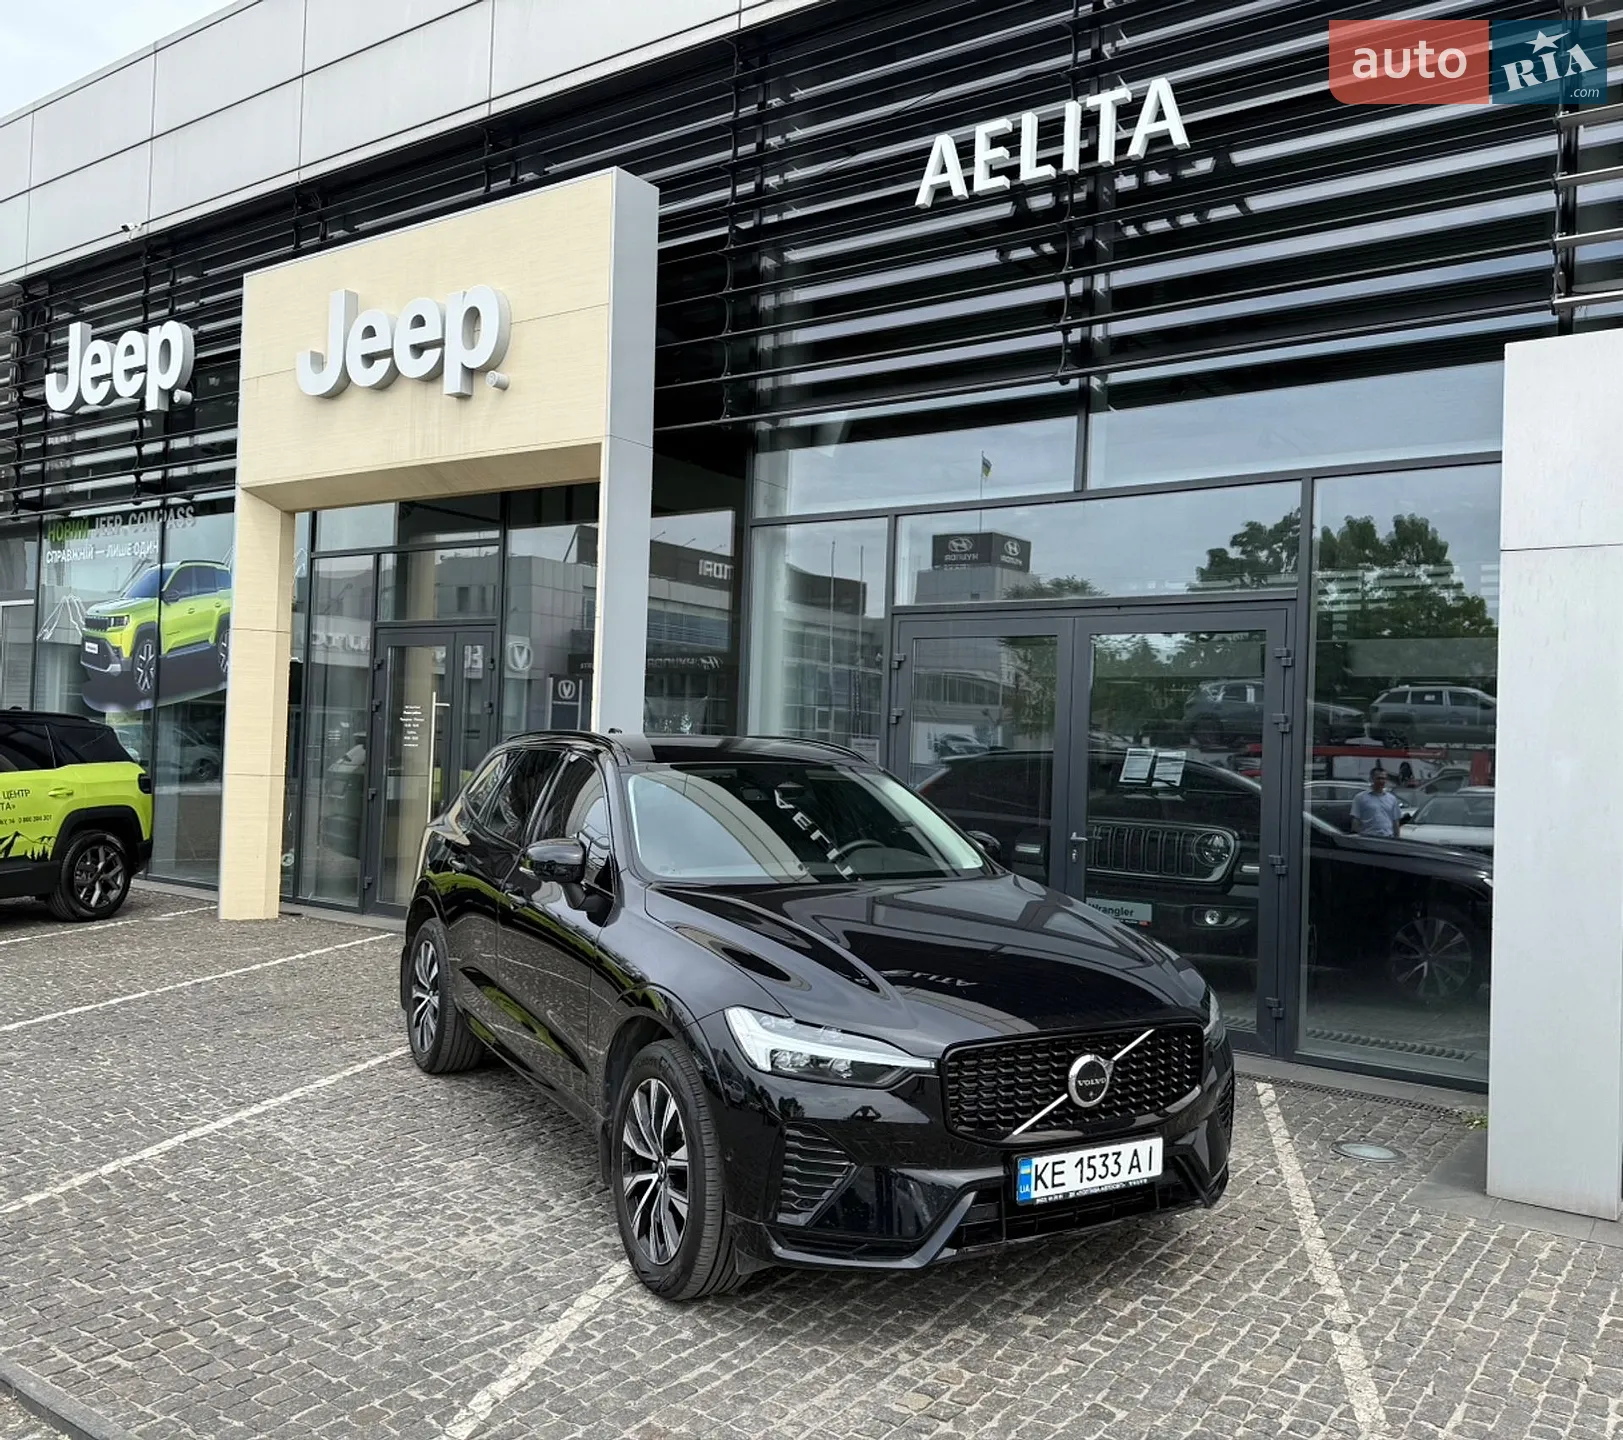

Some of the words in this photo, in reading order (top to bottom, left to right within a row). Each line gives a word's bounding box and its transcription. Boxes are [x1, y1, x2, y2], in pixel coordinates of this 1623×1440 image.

[914, 77, 1191, 209] AELITA
[295, 284, 511, 398] Jeep
[45, 320, 195, 412] Jeep
[47, 515, 91, 541] НОВИЙ
[95, 516, 122, 537] JEEP
[46, 545, 94, 564] СПРАВЖНІЙ
[2, 789, 31, 800] ЦЕНТР
[1077, 1077, 1107, 1087] VOLVO
[1034, 1159, 1066, 1192] KE
[1074, 1151, 1122, 1184] 1533
[1127, 1145, 1153, 1175] AI
[1019, 1185, 1031, 1193] UA
